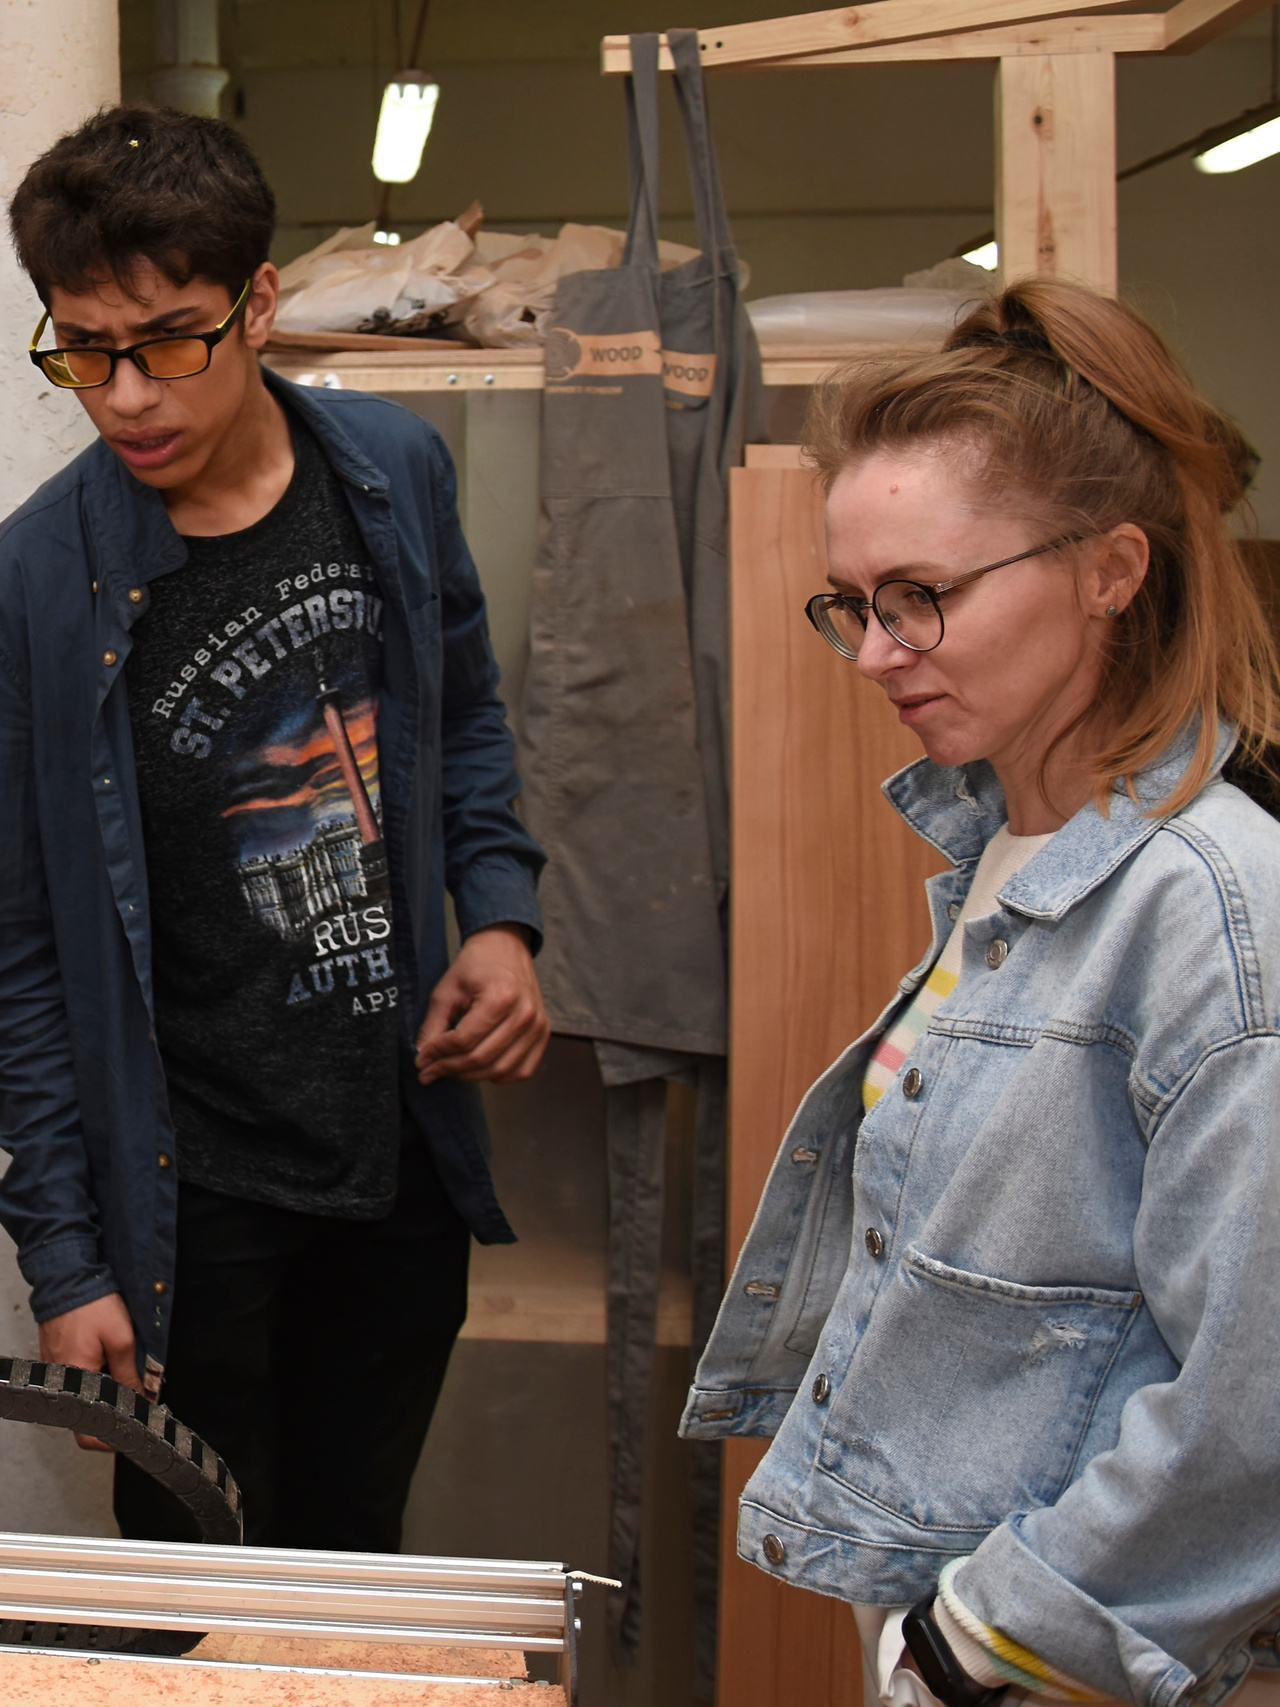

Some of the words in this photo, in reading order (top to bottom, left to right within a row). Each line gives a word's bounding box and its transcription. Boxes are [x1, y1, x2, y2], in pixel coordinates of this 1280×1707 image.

[590, 346, 643, 362] WOOD
[152, 606, 263, 719] Russian
[170, 696, 231, 759] ST.
[314, 906, 391, 957] RUS
[286, 944, 394, 1005] AUTH
